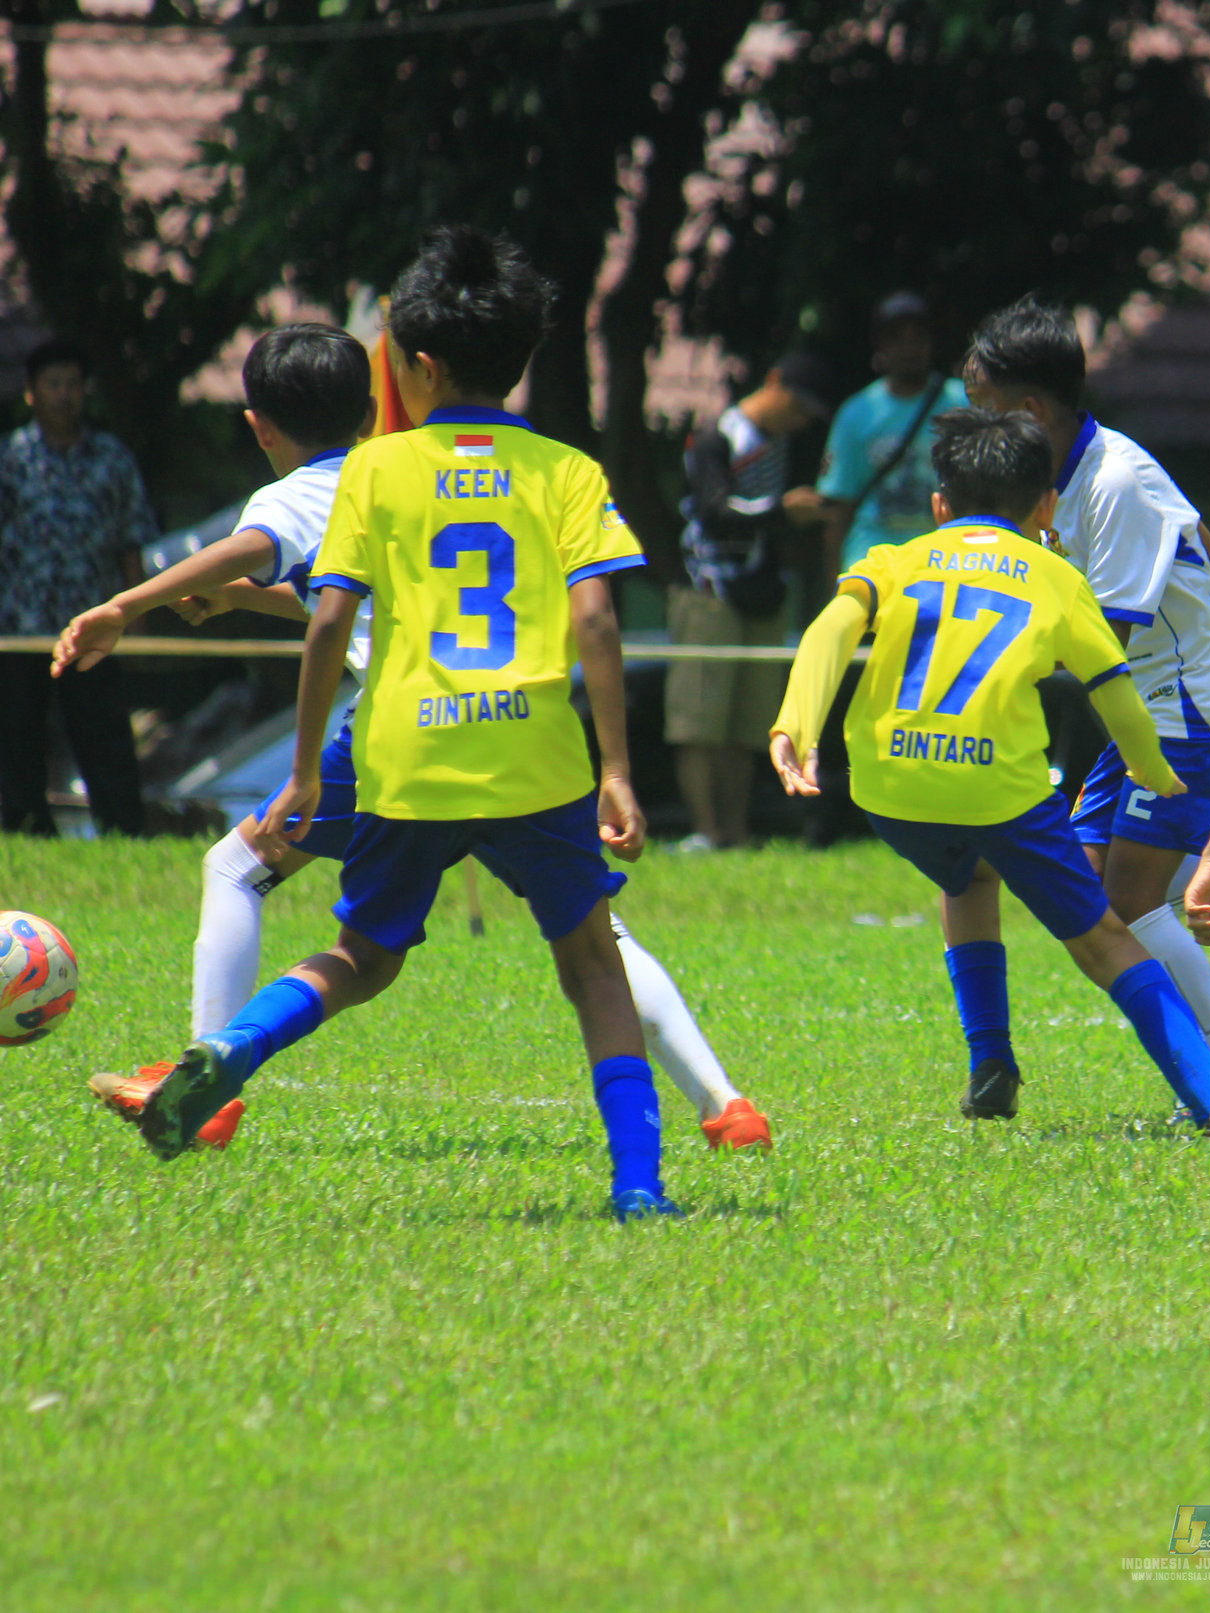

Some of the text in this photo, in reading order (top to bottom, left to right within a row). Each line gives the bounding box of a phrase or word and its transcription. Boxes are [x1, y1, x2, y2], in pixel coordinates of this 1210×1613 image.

[436, 470, 512, 499] KEEN
[926, 549, 1028, 586] RAGNAR
[430, 522, 516, 671] 3
[896, 579, 1034, 717] 17
[417, 690, 530, 727] BINTARO
[890, 729, 995, 767] BINTARO
